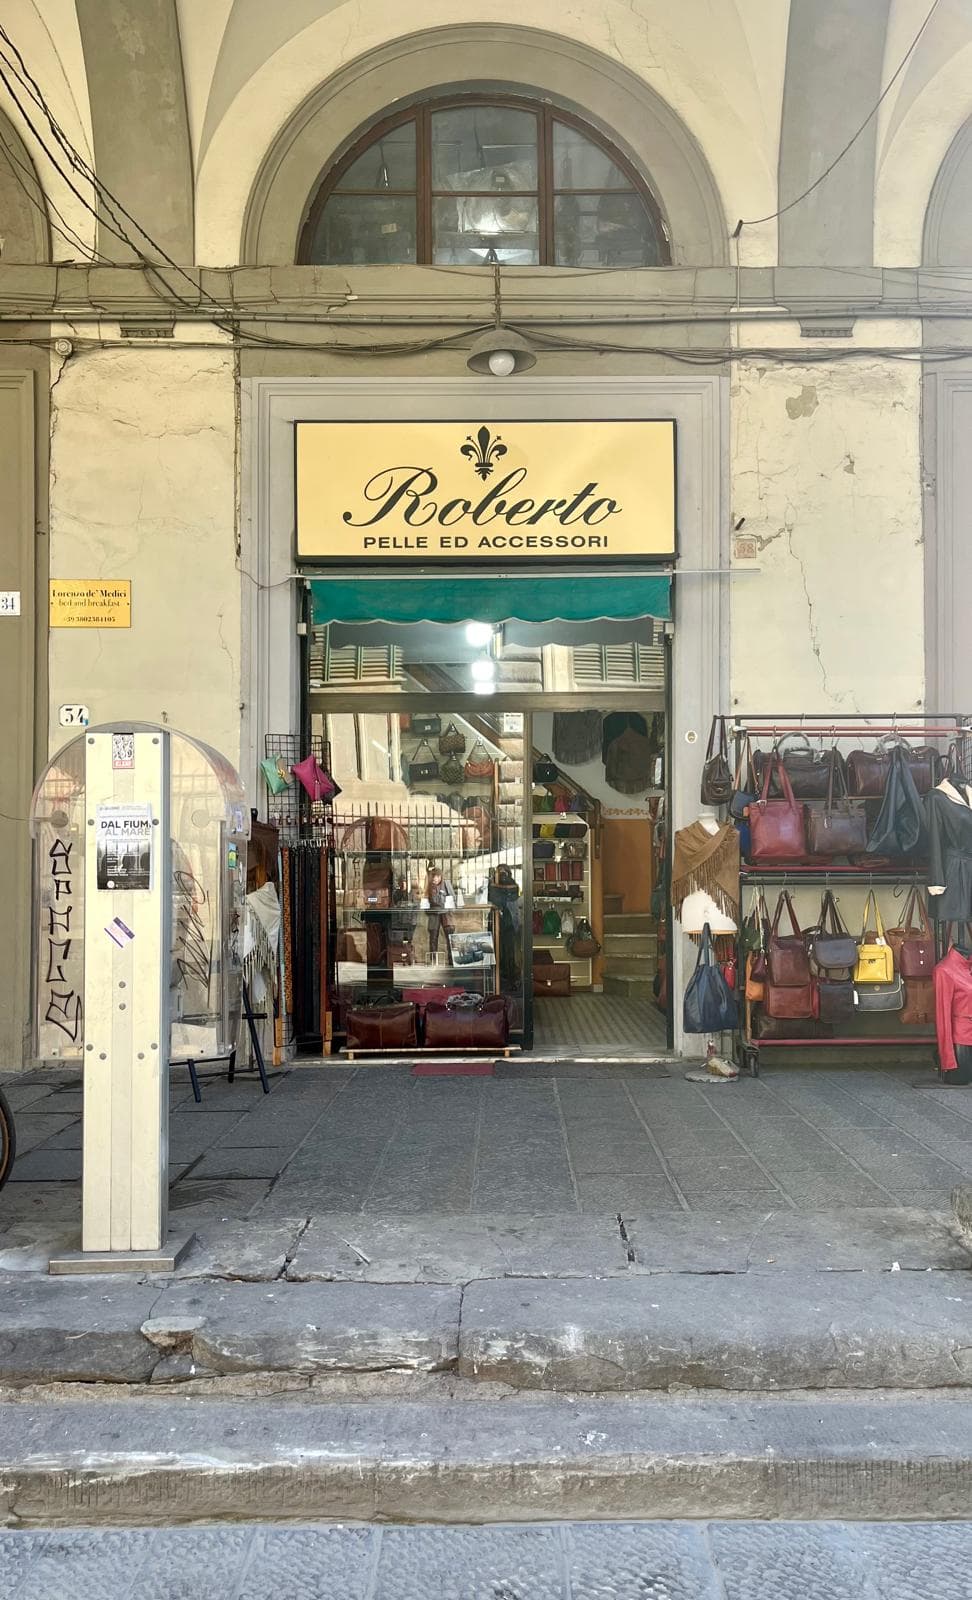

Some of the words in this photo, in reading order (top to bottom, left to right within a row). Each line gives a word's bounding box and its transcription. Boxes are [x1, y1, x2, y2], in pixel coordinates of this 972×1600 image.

[343, 466, 623, 527] Roberto
[364, 537, 428, 549] PELLE
[440, 536, 469, 548] ED
[478, 535, 609, 548] ACCESSORI
[52, 589, 85, 598] Lorenzo
[100, 589, 127, 598] Medici
[58, 599, 72, 607] bed
[74, 599, 87, 607] and
[87, 599, 120, 607] breakfast
[101, 820, 121, 829] DAL
[105, 828, 119, 836] AL
[121, 828, 151, 836] MARE
